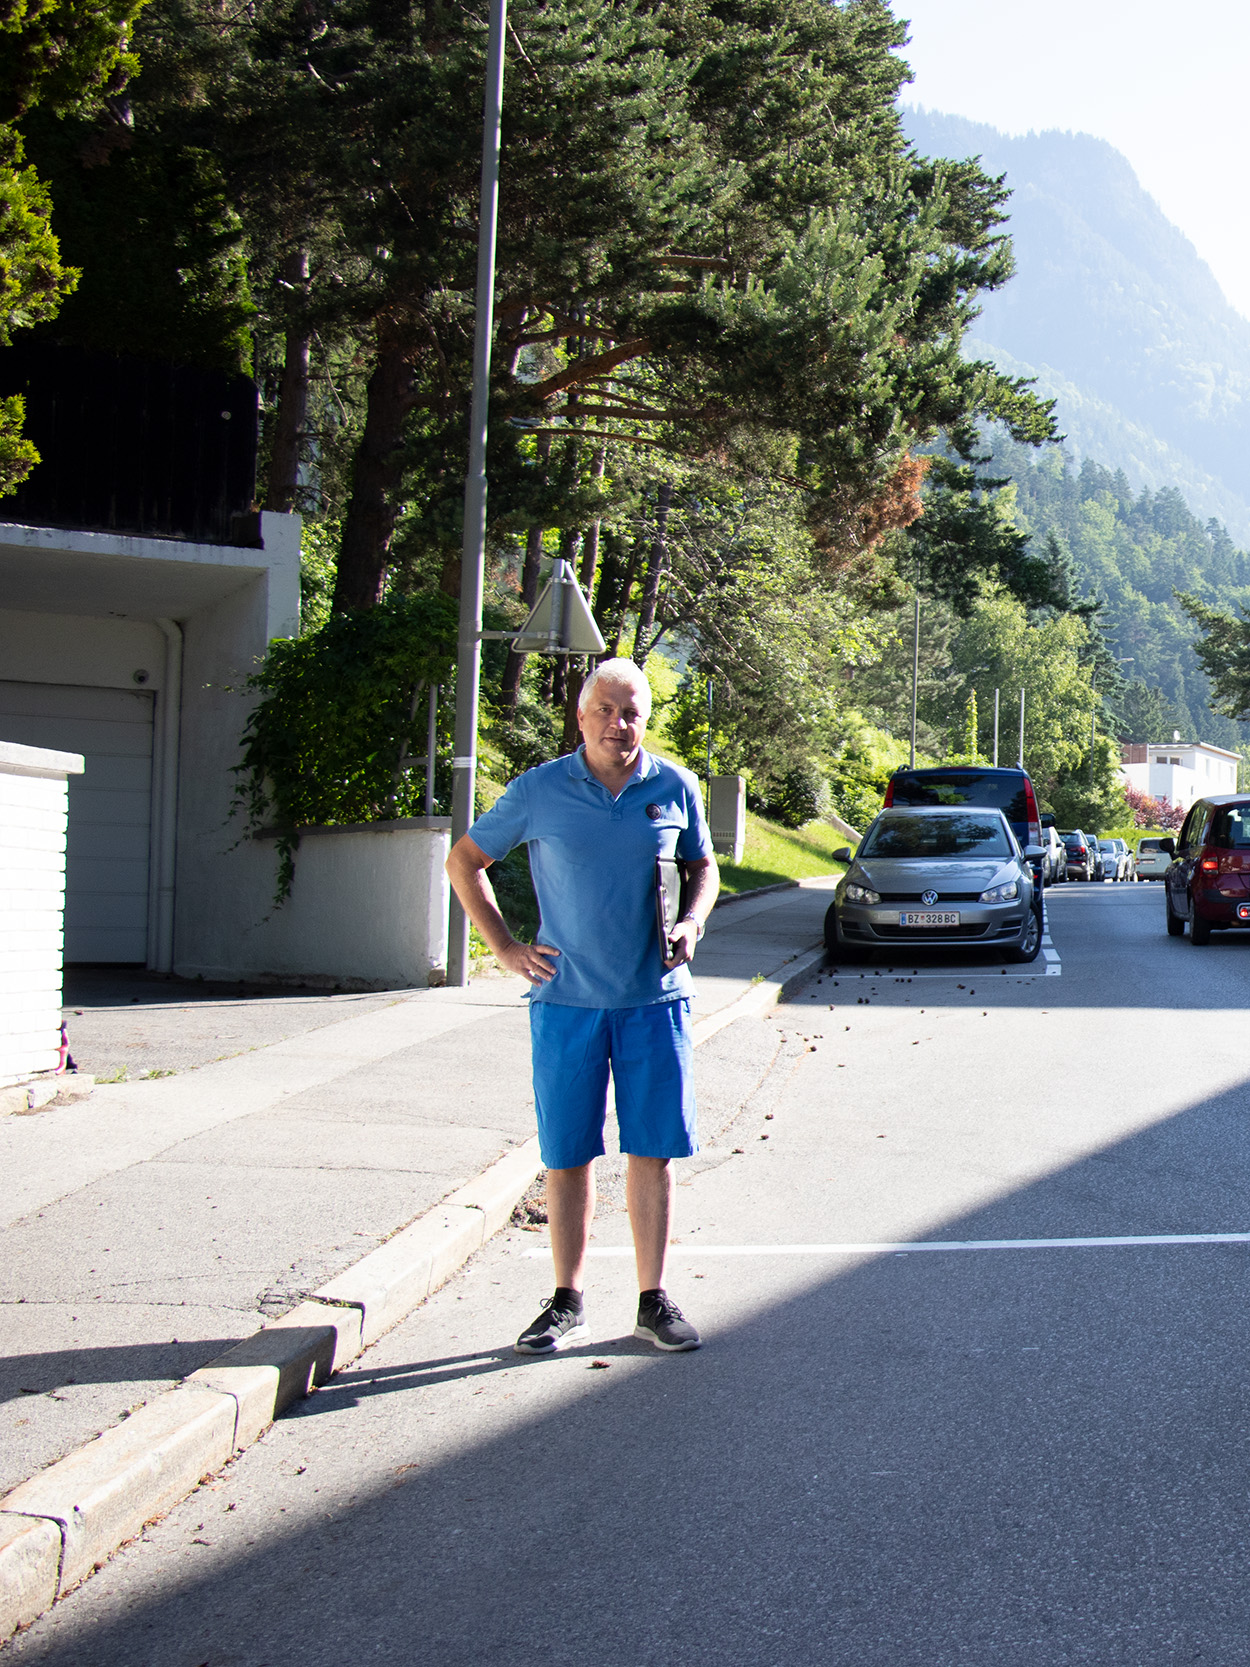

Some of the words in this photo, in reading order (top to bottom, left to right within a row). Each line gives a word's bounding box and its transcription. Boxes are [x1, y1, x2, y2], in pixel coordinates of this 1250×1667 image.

[908, 914, 920, 924] BZ
[926, 914, 943, 924] 328
[944, 914, 956, 924] BC
